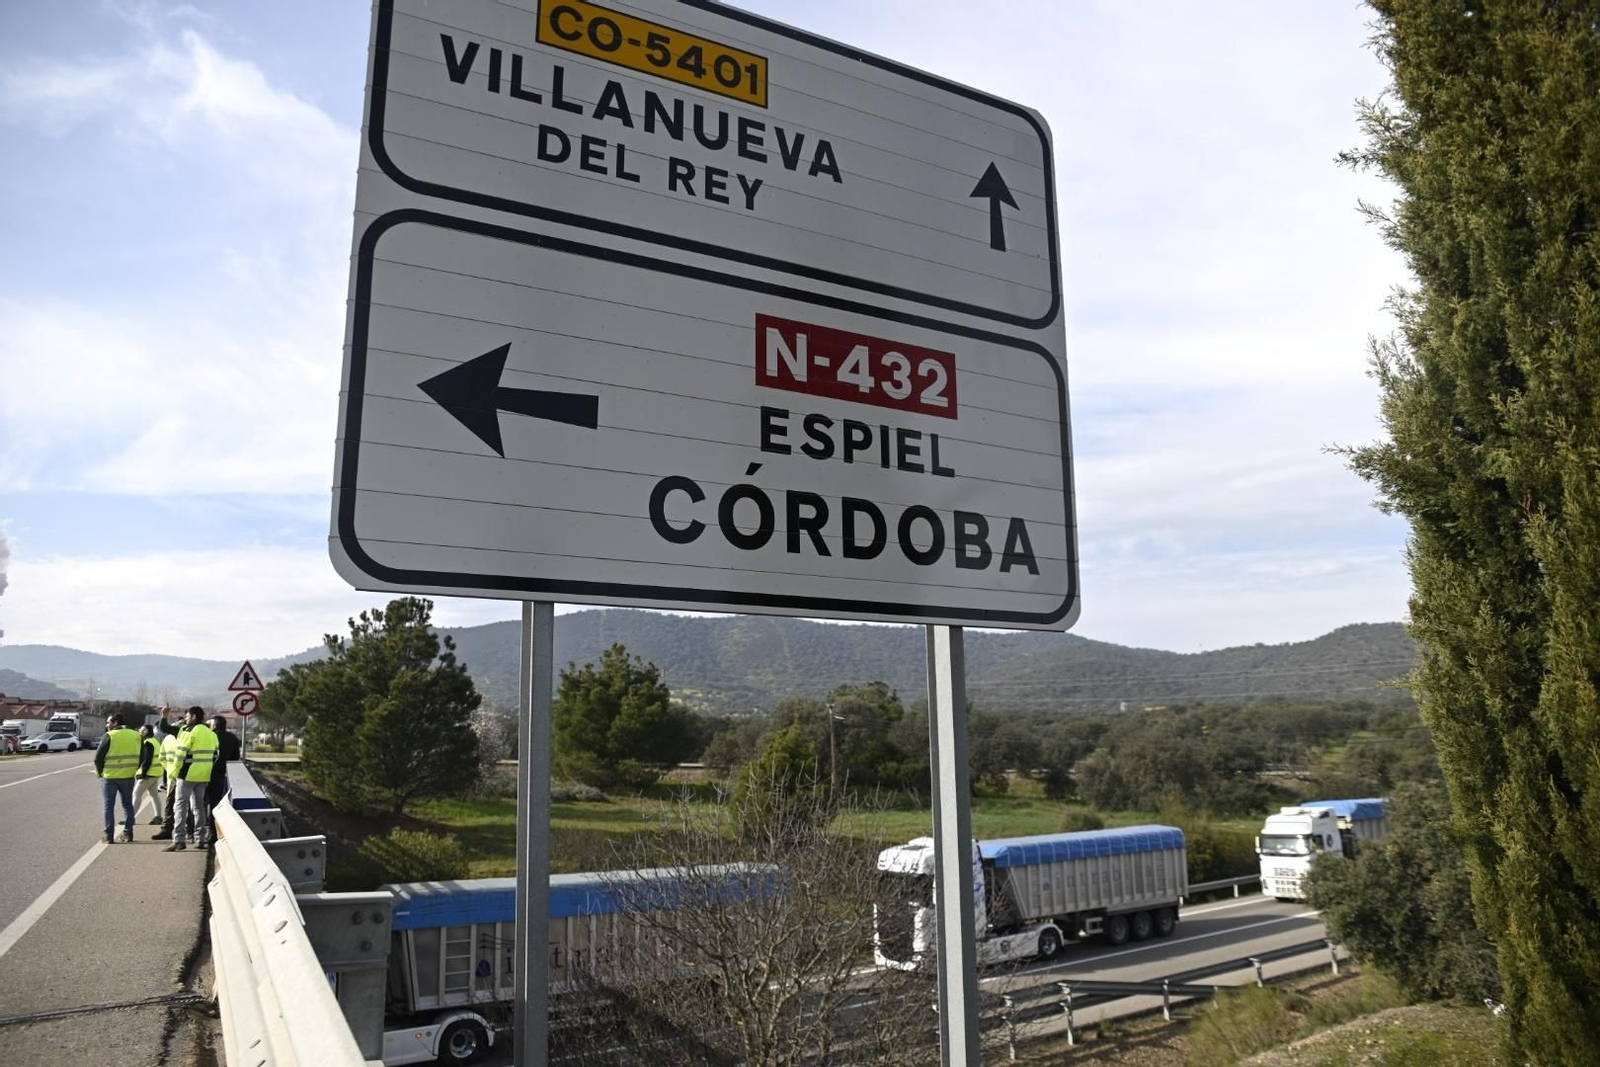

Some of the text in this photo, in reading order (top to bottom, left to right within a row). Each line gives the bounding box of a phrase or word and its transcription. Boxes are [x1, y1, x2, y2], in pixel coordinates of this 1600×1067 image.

[550, 5, 758, 96] CO-5401
[440, 34, 843, 184] VILLANUEVA
[537, 124, 764, 211] DEL REY
[765, 328, 950, 408] N-432
[760, 406, 956, 478] ESPIEL
[649, 462, 1040, 576] CÓRDOBA
